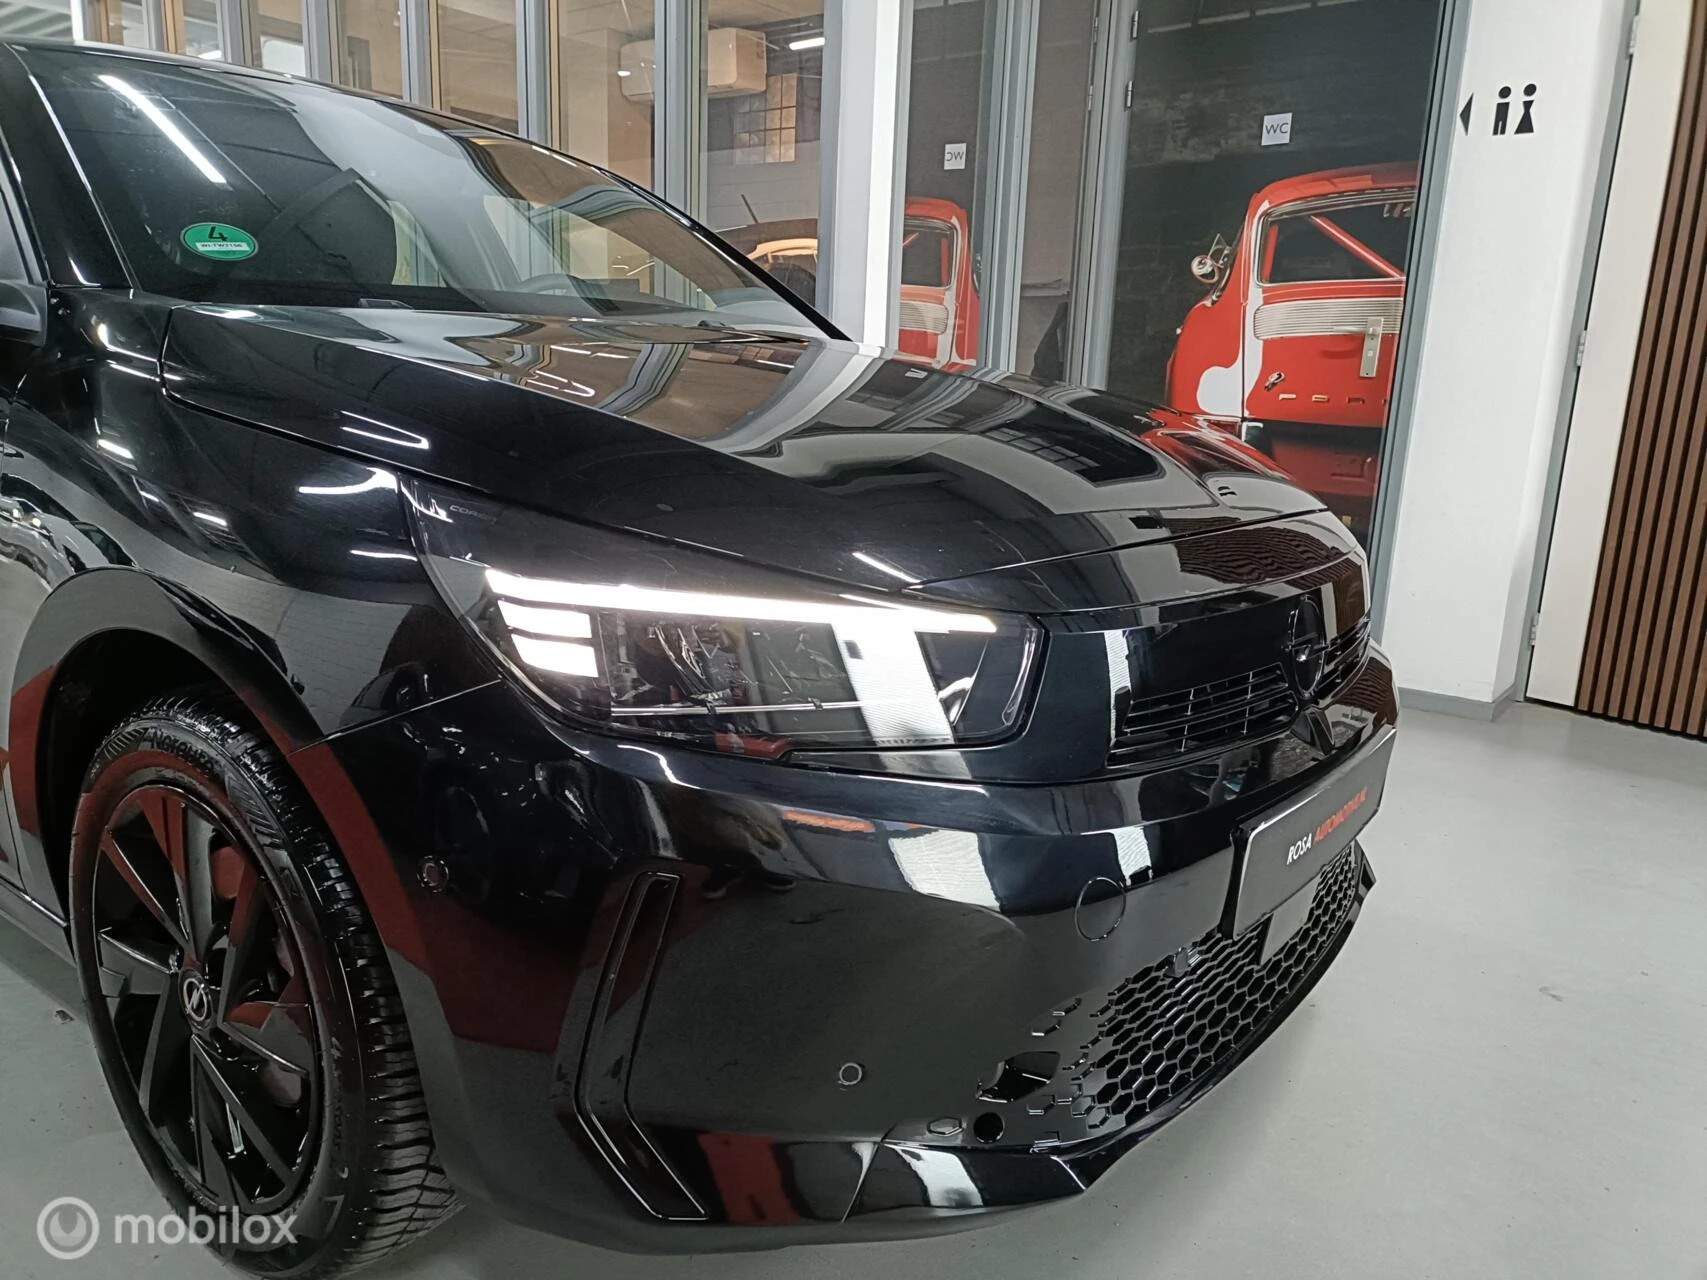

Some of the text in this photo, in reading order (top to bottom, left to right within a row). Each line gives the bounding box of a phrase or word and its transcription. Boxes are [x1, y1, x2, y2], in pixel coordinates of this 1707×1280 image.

[1265, 122, 1289, 135] WC
[208, 226, 228, 241] 4
[1286, 832, 1312, 865] ROSA
